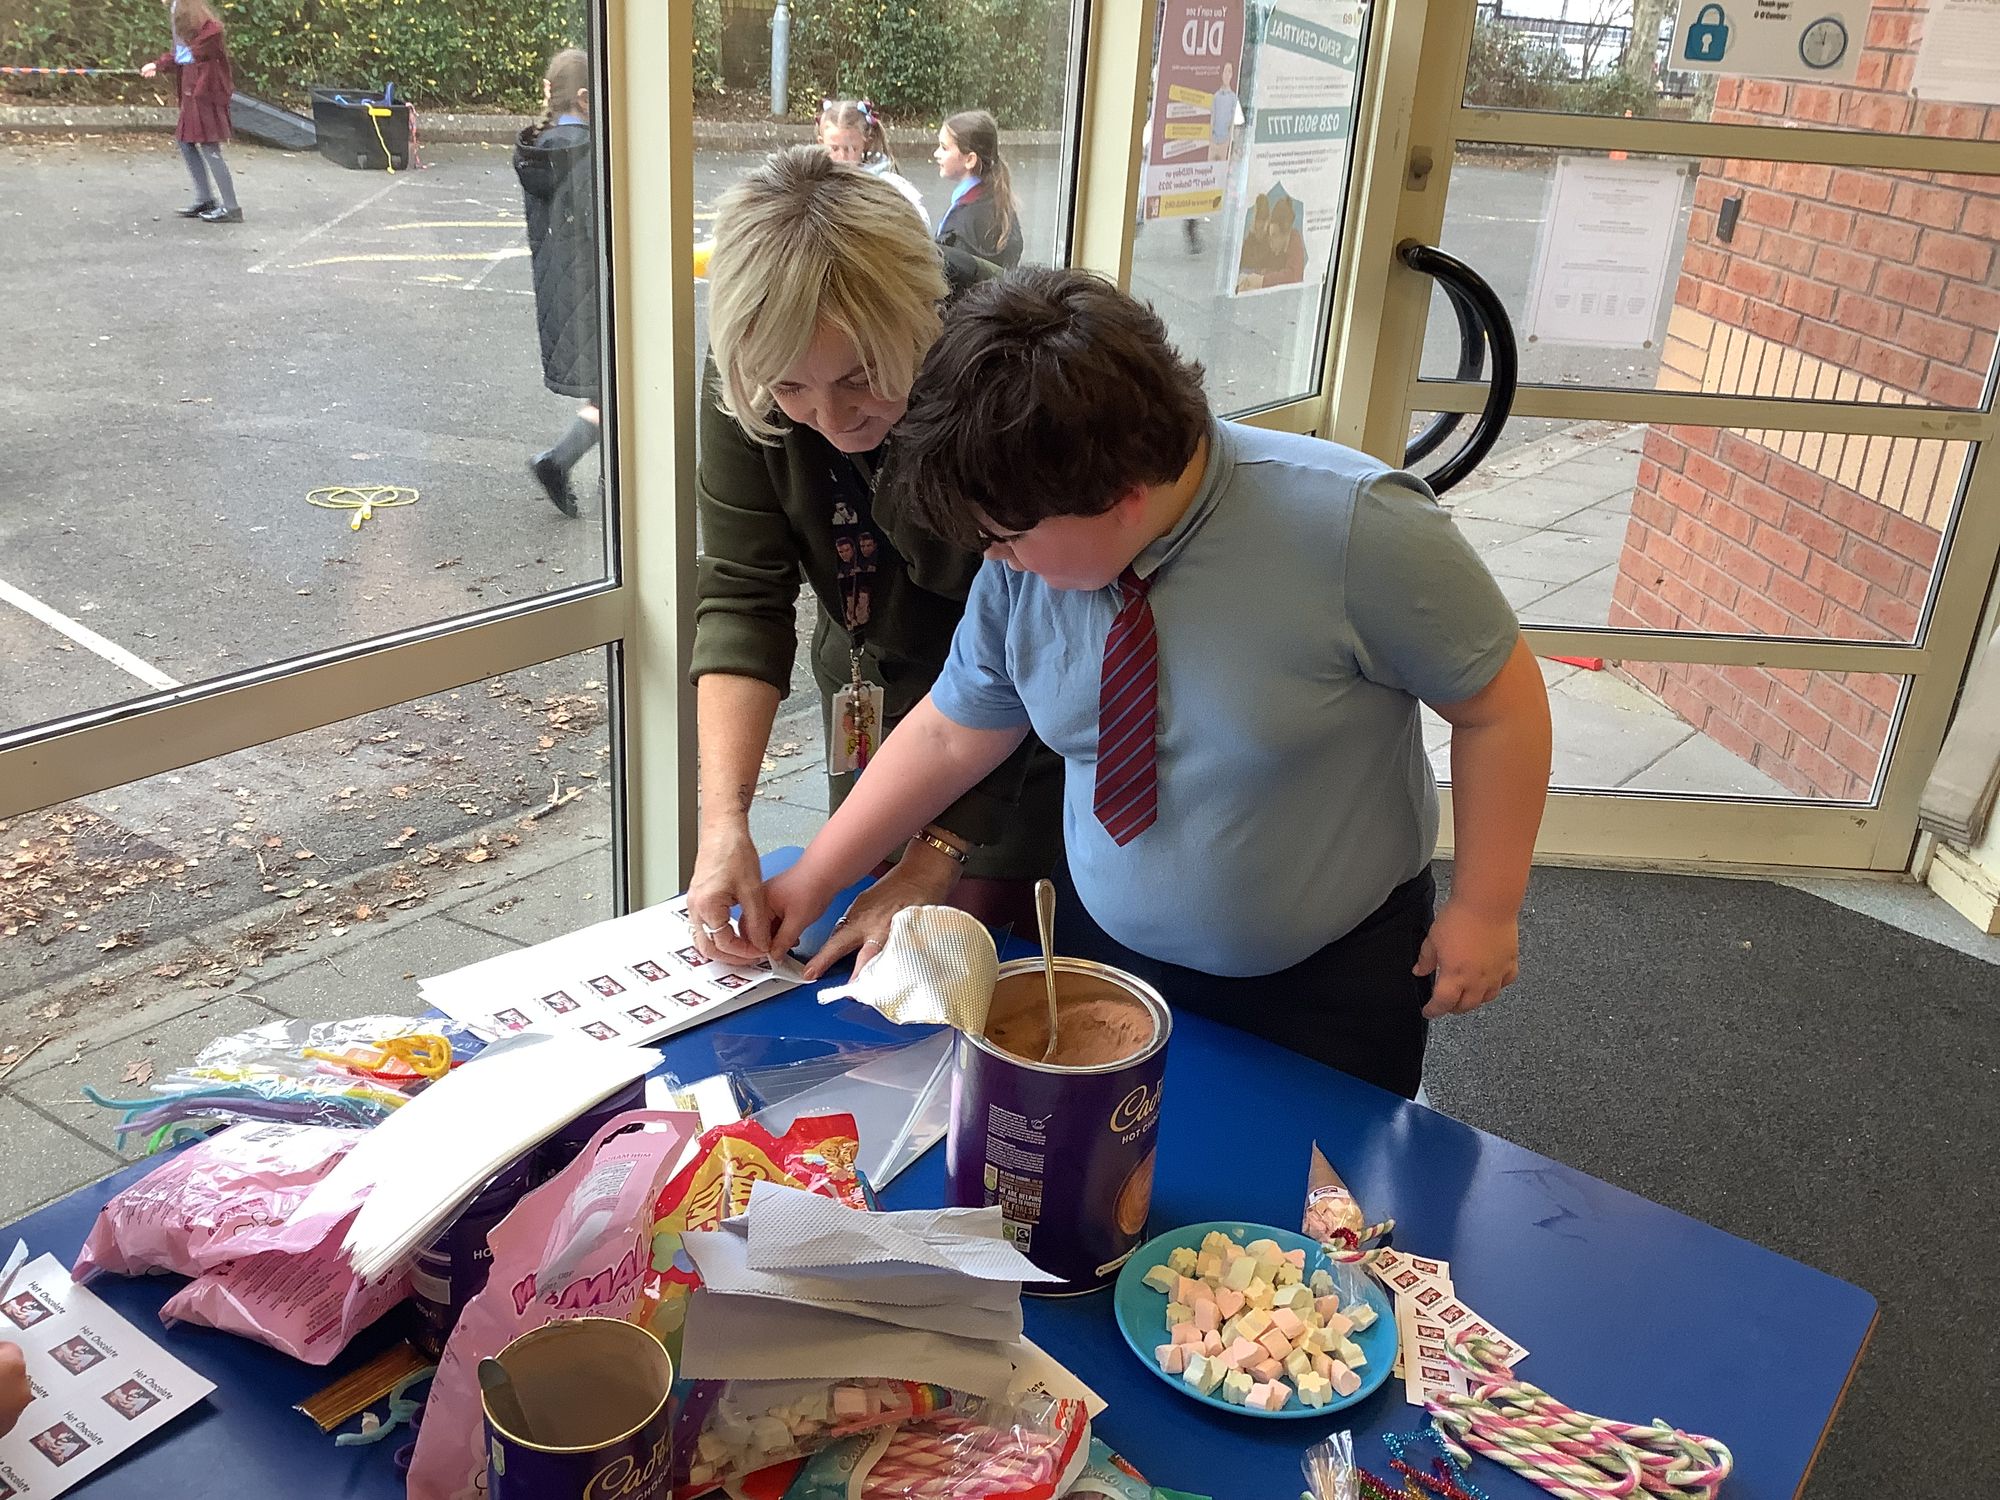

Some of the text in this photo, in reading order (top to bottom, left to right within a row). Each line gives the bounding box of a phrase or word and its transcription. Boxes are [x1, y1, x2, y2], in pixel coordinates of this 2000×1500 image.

[1121, 1128, 1141, 1145] HOT
[28, 1280, 66, 1314] Hot Chocolate
[79, 1325, 119, 1358] Hot Chocolate
[133, 1368, 174, 1400] Hot Chocolate
[63, 1410, 105, 1446] Hot Chocolate
[1, 1465, 31, 1493] Chocolate
